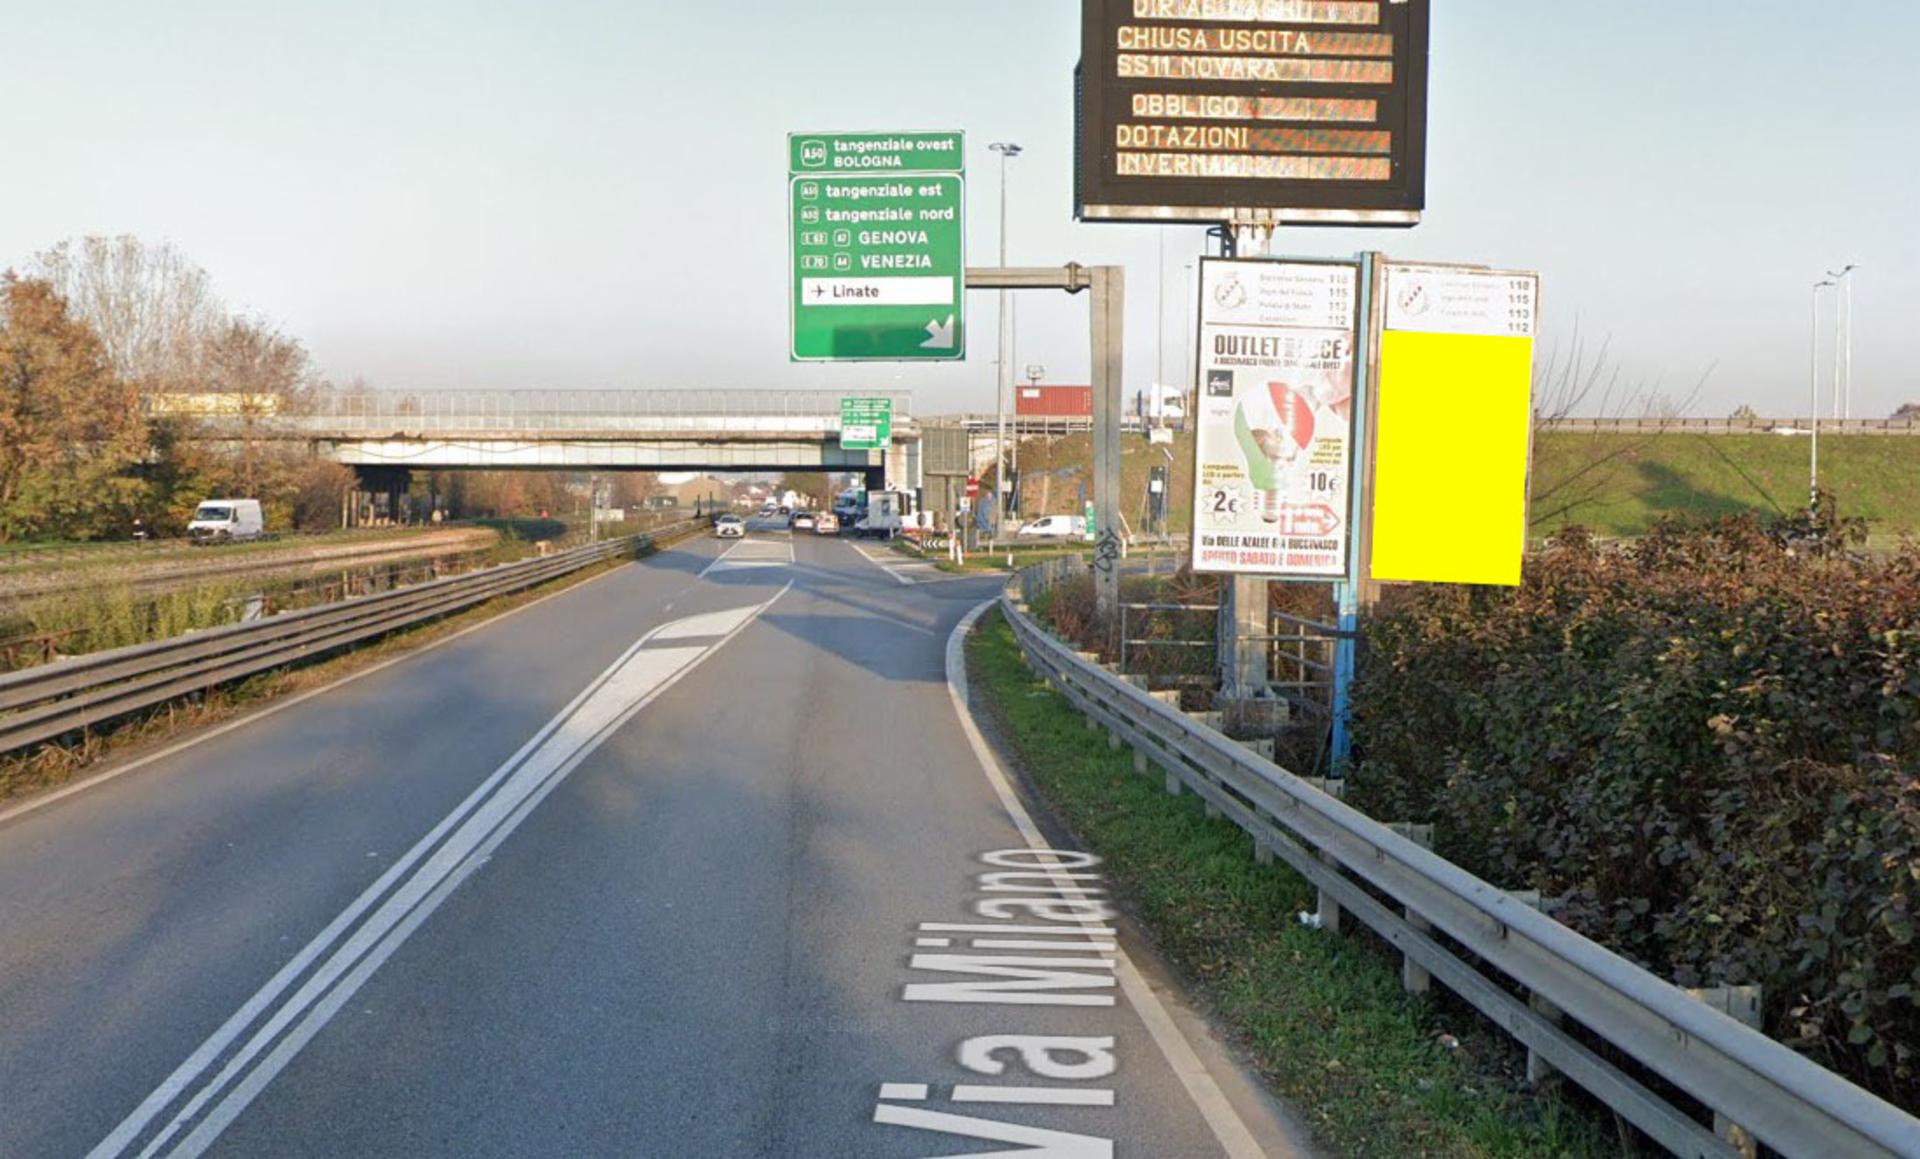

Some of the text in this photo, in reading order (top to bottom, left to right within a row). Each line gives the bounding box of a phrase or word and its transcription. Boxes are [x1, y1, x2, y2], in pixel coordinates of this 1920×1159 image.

[1118, 27, 1311, 53] CHIUSA USCITA
[1117, 54, 1279, 80] SS11 NOVARA
[1132, 94, 1239, 118] OBBLIGO
[1116, 125, 1247, 148] DOTAZIONI
[804, 147, 825, 159] A50
[834, 138, 954, 153] tangenziale ovest
[833, 155, 902, 167] BOLOGNA
[826, 184, 913, 199] tangenziale
[919, 183, 942, 196] est
[826, 208, 913, 223] tangenziale
[920, 206, 954, 220] nord
[858, 230, 928, 245] GENOVA
[860, 254, 932, 268] VENEZIA
[833, 284, 879, 298] Linate
[1508, 322, 1529, 332] 112
[1214, 334, 1280, 356] OUTLET
[1202, 536, 1215, 546] Via
[1216, 535, 1240, 547] DELLE
[1240, 551, 1277, 565] SABATO
